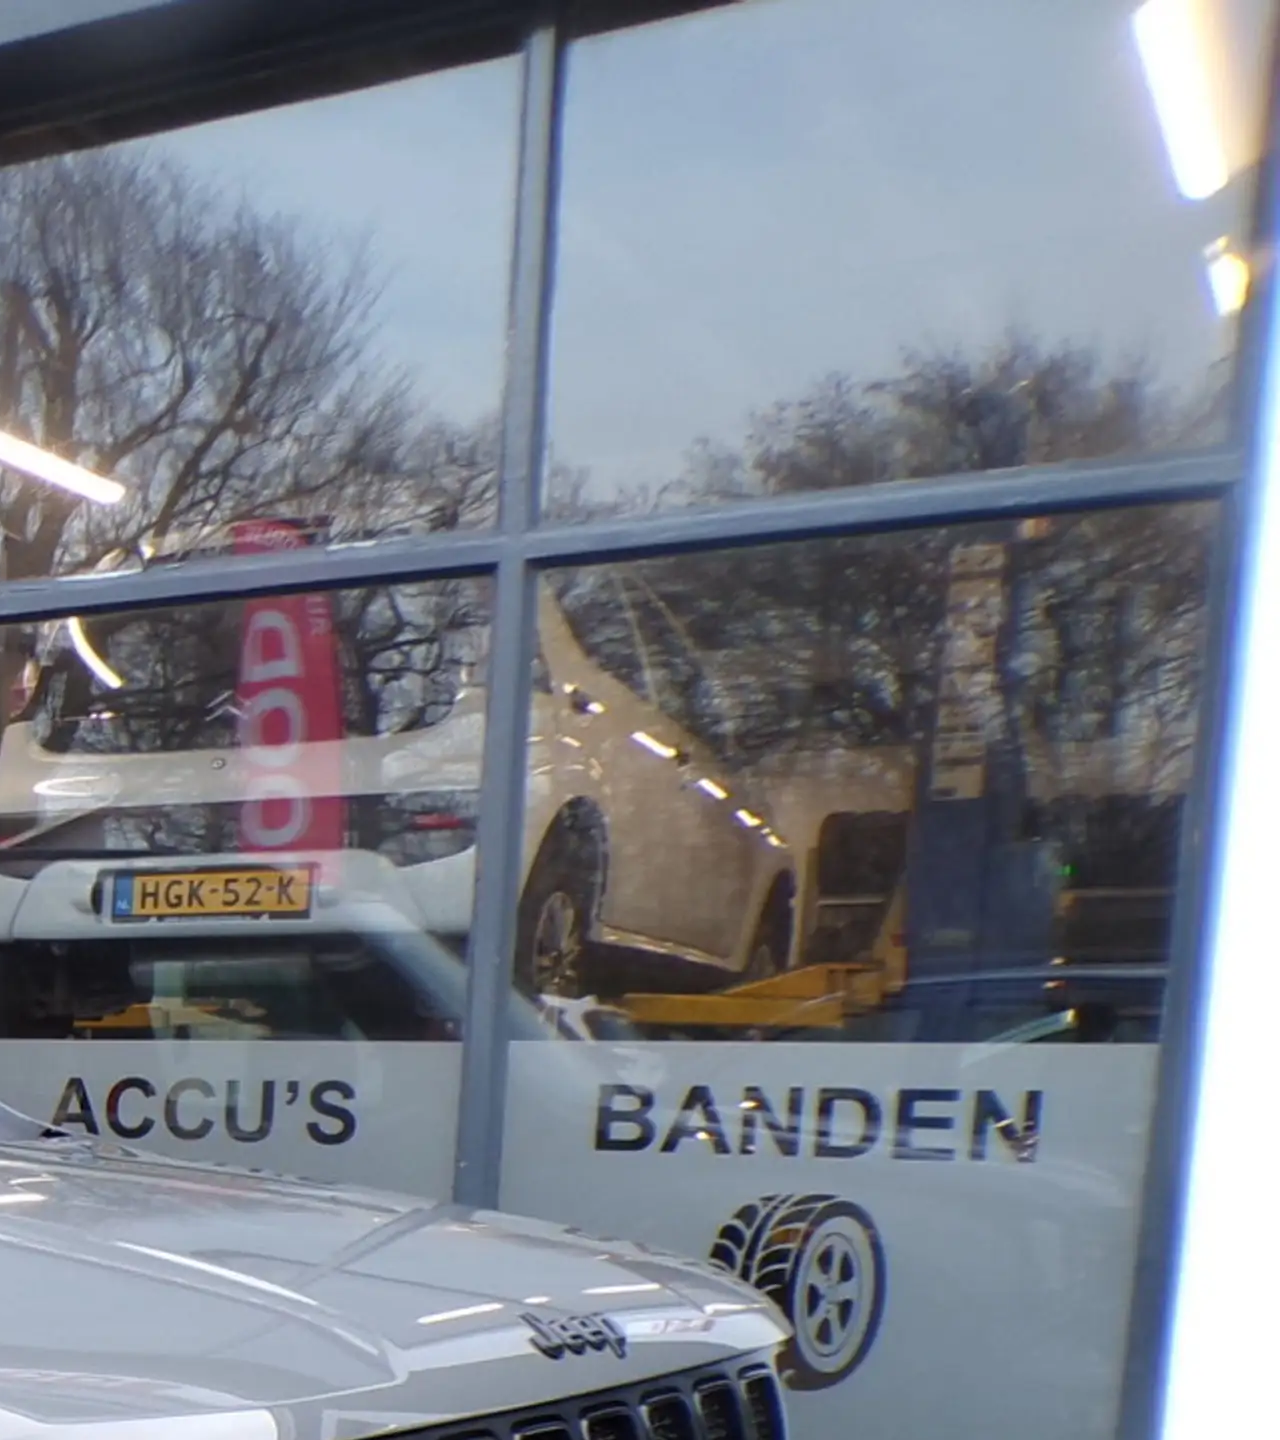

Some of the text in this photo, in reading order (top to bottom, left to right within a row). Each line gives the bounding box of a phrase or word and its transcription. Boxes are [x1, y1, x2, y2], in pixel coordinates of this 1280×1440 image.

[140, 875, 297, 910] HGK-52-K
[40, 1076, 358, 1146] ACCU'S
[594, 1083, 1044, 1163] BANDEN
[517, 1312, 627, 1360] Jeep
